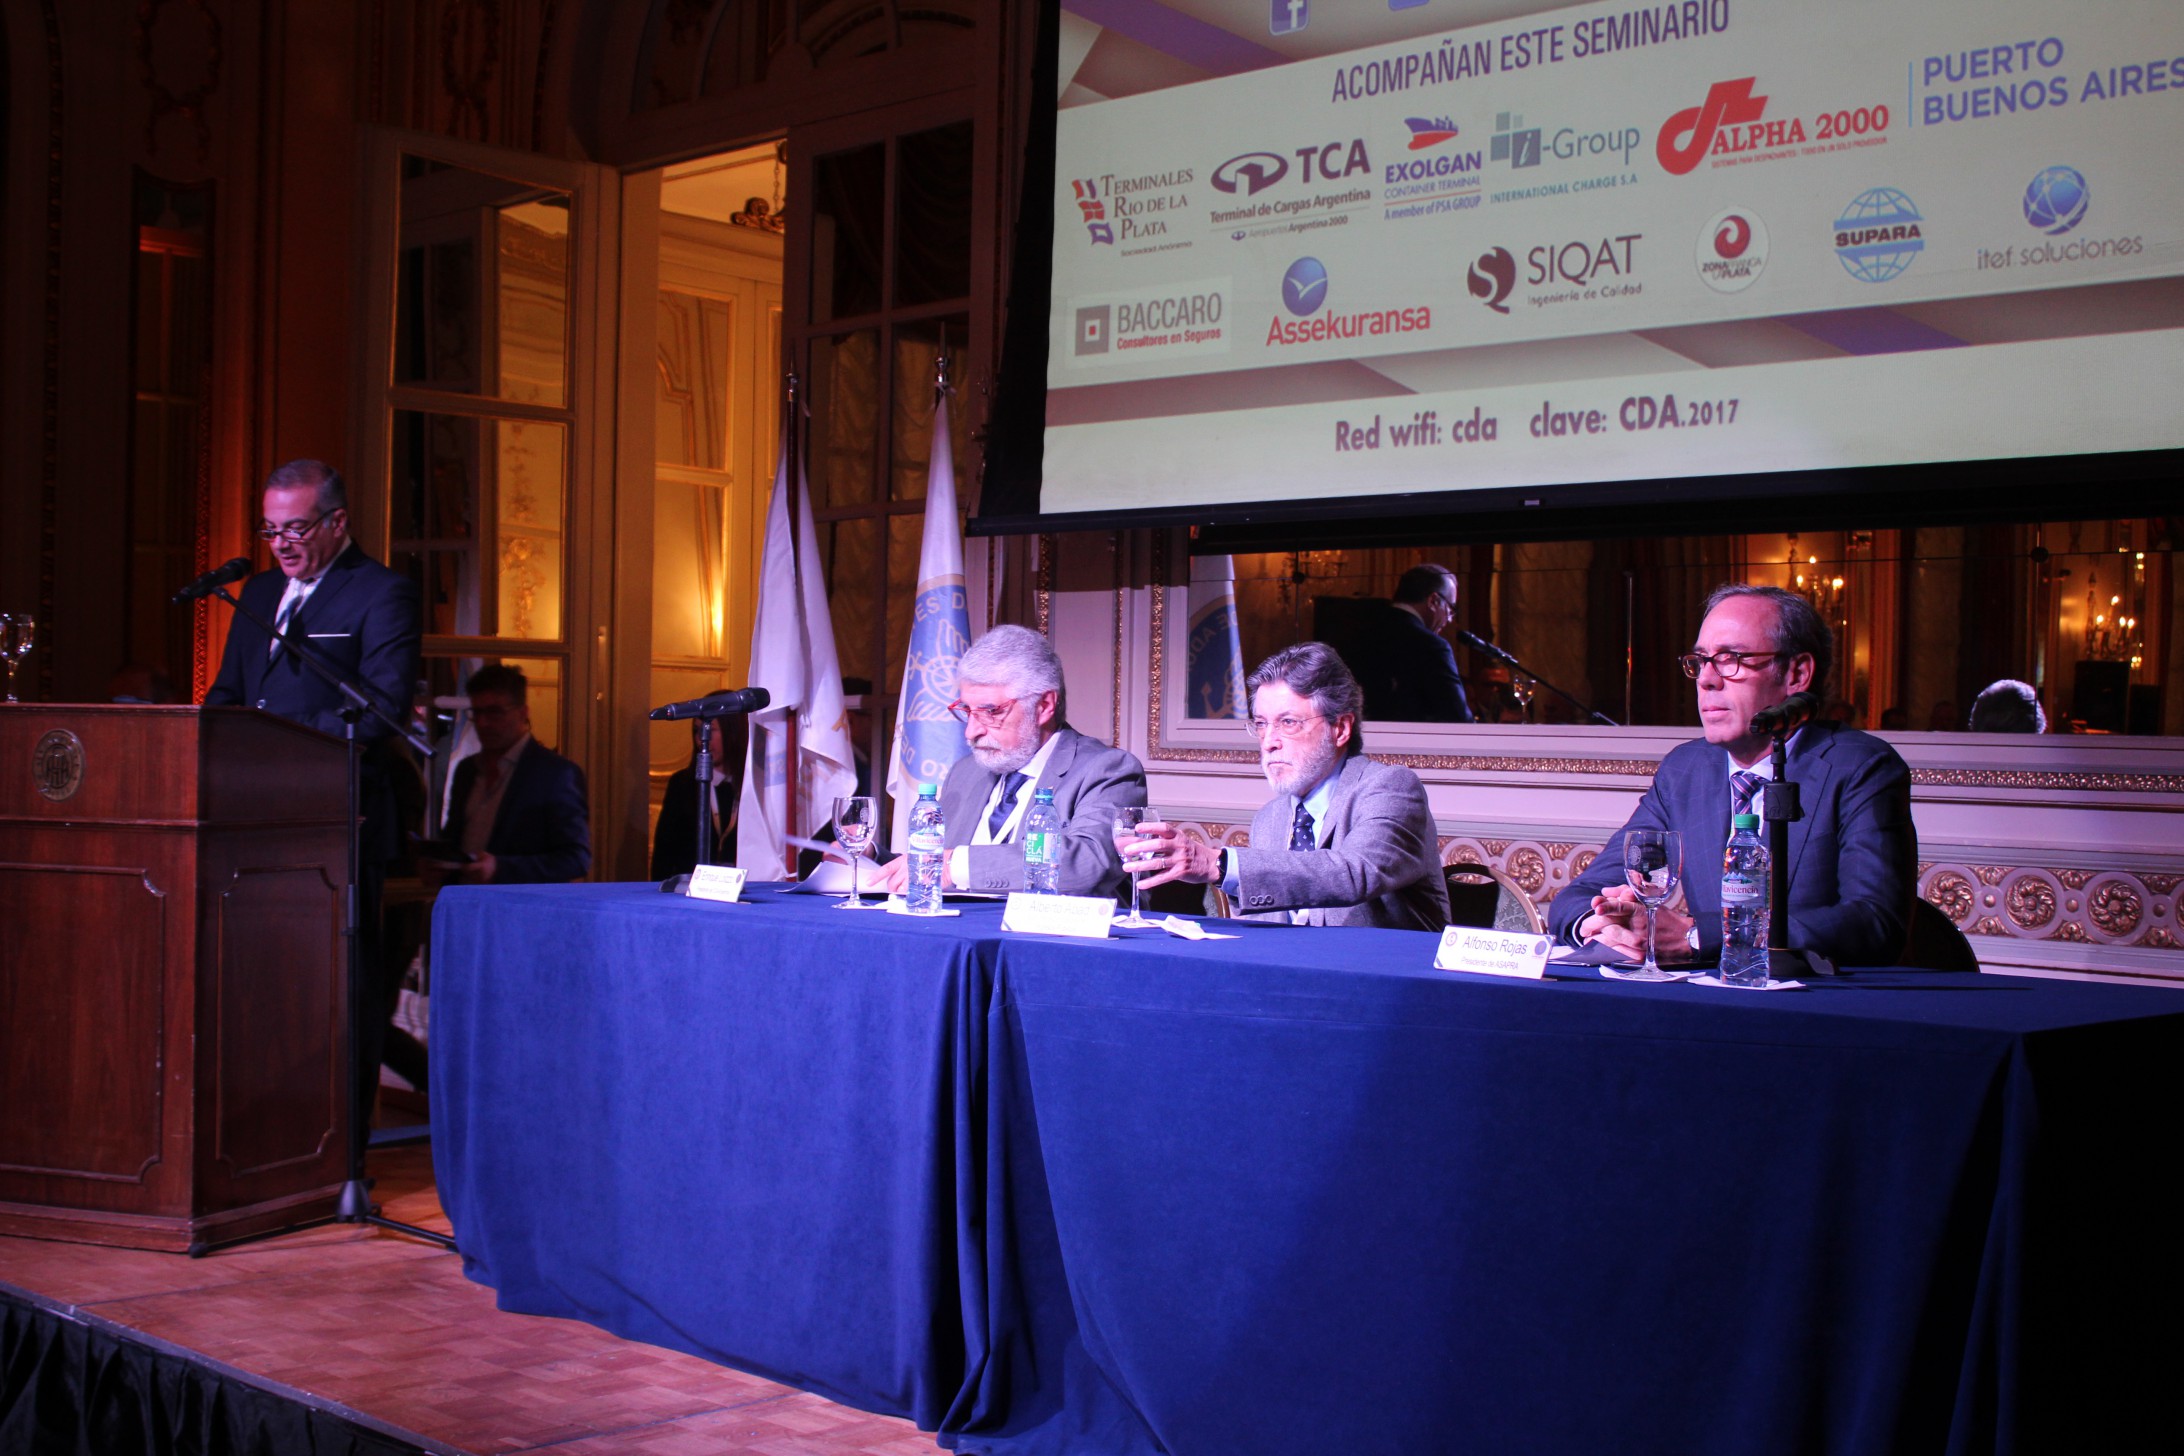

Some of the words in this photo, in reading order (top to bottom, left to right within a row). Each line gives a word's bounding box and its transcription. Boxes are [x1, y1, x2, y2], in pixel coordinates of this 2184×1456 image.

[1332, 38, 1491, 102] ACOMPAÑAN
[1501, 25, 1564, 71] ESTE
[1572, 0, 1729, 58] SEMINARIO
[1924, 36, 2064, 87] PUERTO
[1923, 76, 2069, 126] BUENOS
[2080, 57, 2184, 103] AIRES
[1711, 117, 1807, 155] ALPHA
[1815, 104, 1889, 140] 2000
[1295, 138, 1371, 184] TCA
[1385, 150, 1482, 184] EXOLGAN
[1101, 168, 1194, 197] TERMINALES
[1384, 181, 1436, 199] CONTAINER
[1438, 175, 1481, 190] TERMINAL
[1490, 183, 1569, 204] INTERNATIONAL
[1572, 175, 1618, 192] CHARGE
[1146, 197, 1166, 213] DE
[1169, 194, 1188, 209] LA
[1210, 205, 1256, 224] Terminal
[1257, 203, 1272, 217] de
[1273, 197, 1311, 216] Cargas
[1312, 187, 1372, 209] Argentina
[1384, 208, 1391, 220] A
[1120, 218, 1168, 240] PLATA
[1288, 217, 1328, 234] Argentina
[1328, 214, 1349, 226] 2000
[1835, 223, 1922, 248] SUPARA
[1527, 233, 1643, 287] SIQAT
[1976, 245, 2014, 271] itef
[2020, 234, 2144, 267] soluciones
[1583, 288, 1597, 300] de
[1600, 282, 1643, 298] Calidad
[1117, 292, 1222, 334] BACCARO
[1265, 306, 1431, 347] Assekuransa
[1116, 334, 1169, 350] Consultores
[1170, 334, 1182, 345] en
[1184, 328, 1222, 345] Seguros
[1335, 414, 1381, 452] Red
[1389, 410, 1442, 447] wifi:
[1452, 406, 1498, 443] cda
[1529, 401, 1607, 438] clave:
[1619, 394, 1740, 431] CDA.2017
[1462, 935, 1498, 952] Alfonso
[1500, 939, 1528, 957] Rojas
